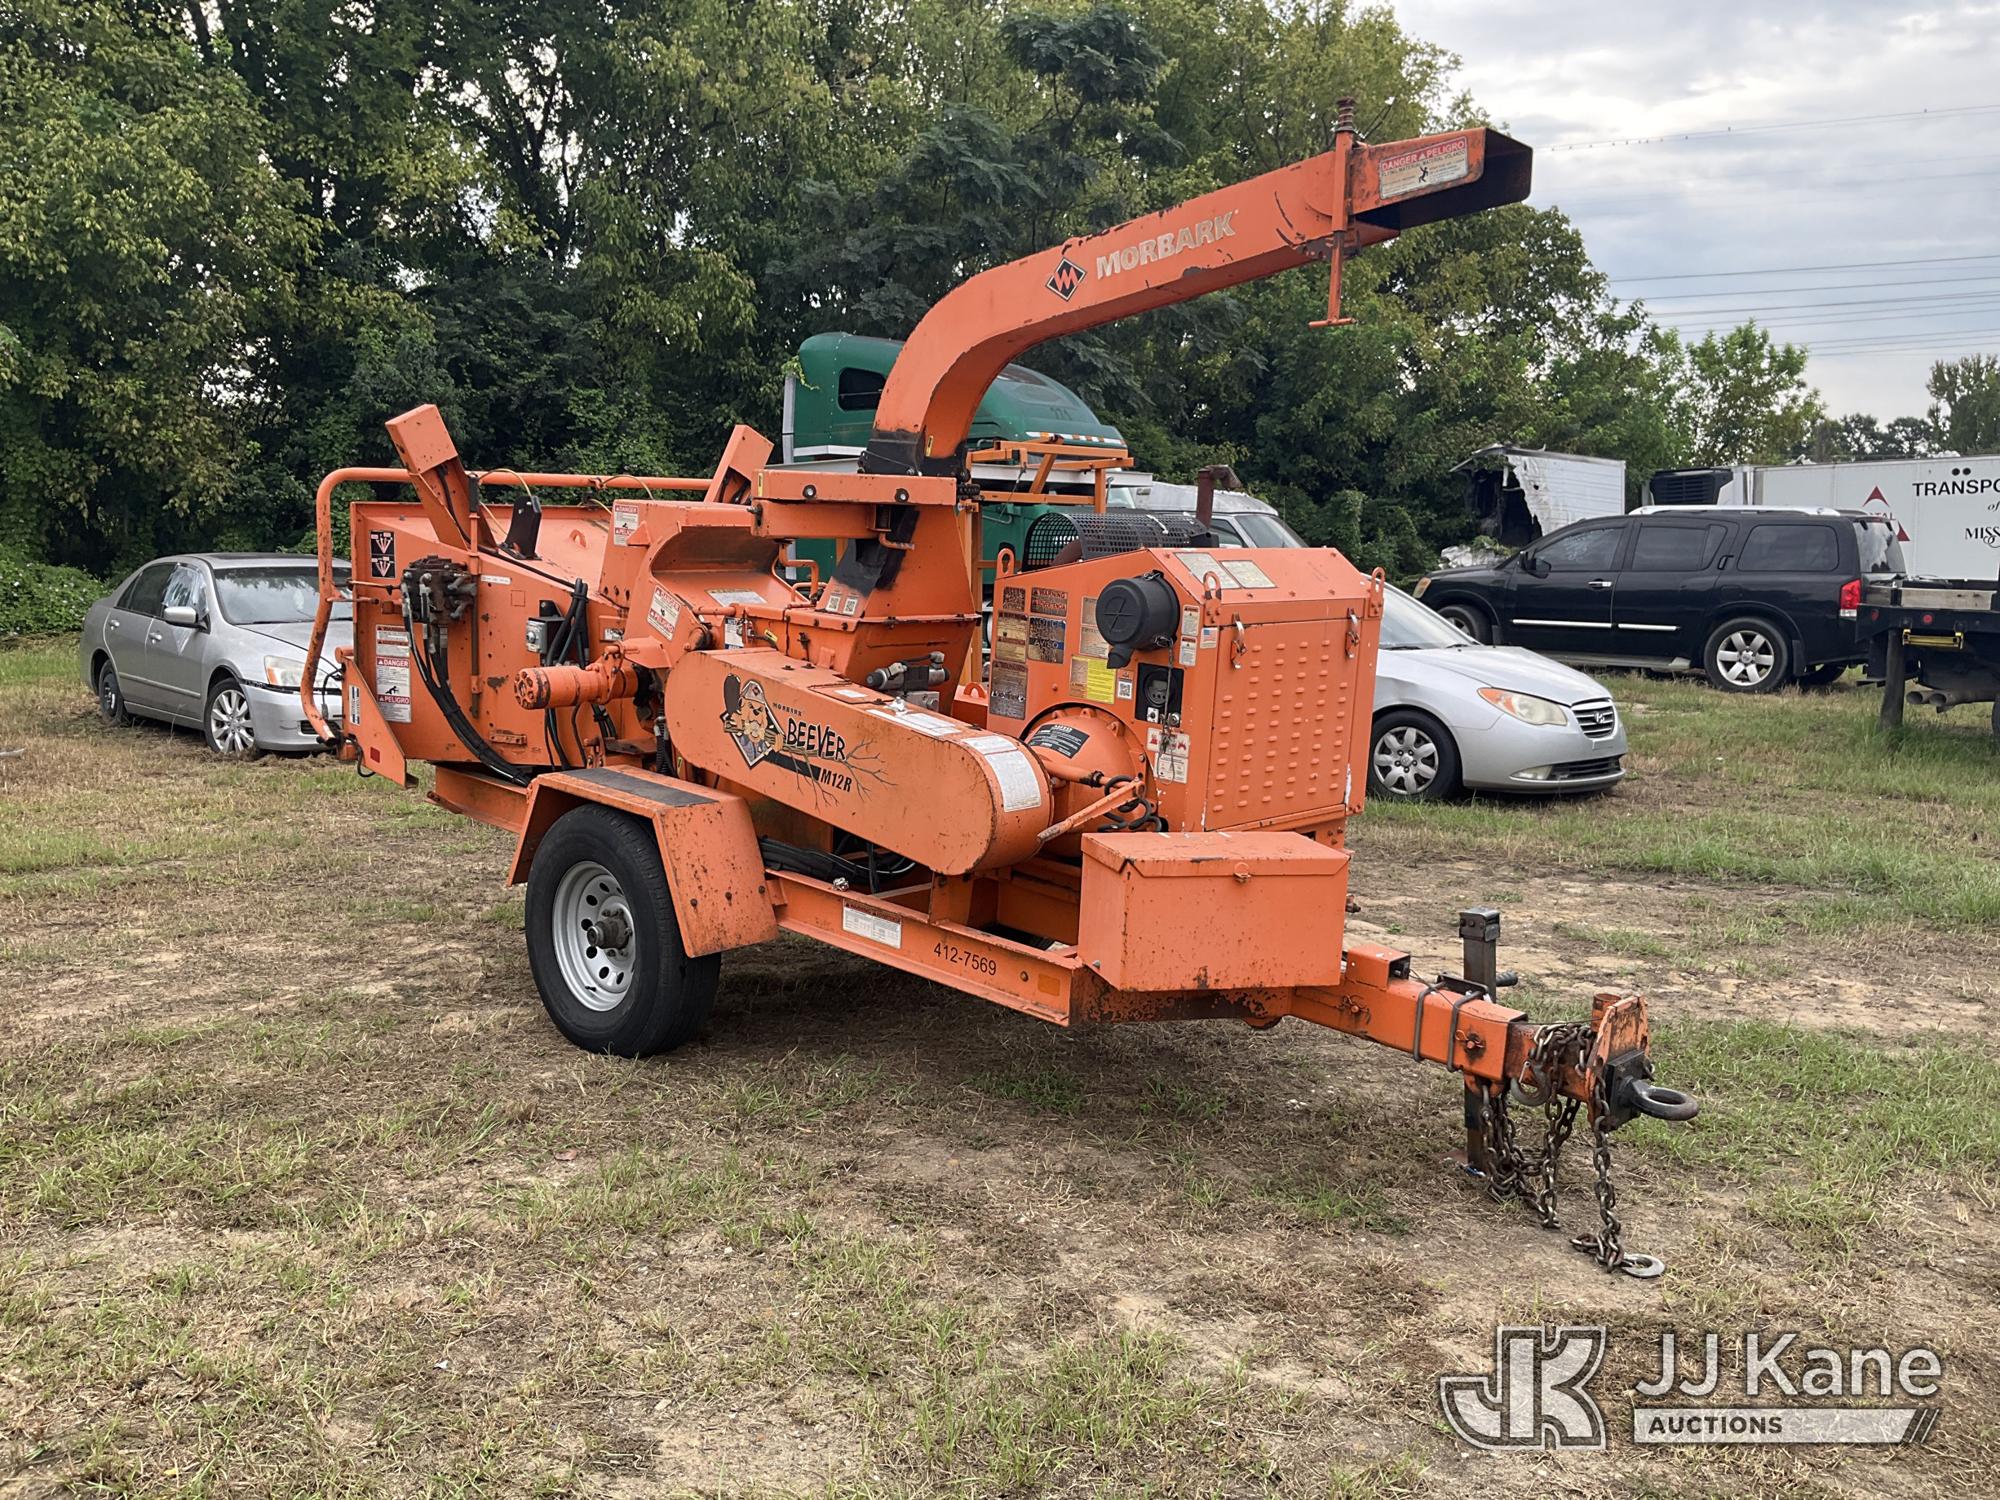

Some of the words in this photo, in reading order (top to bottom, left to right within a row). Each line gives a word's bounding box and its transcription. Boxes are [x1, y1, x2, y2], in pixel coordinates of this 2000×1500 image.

[1382, 153, 1418, 171] DANGER
[1426, 140, 1465, 158] PELIGRO
[1096, 211, 1236, 280] MORBARK
[1034, 639, 1059, 649] AVISO
[383, 659, 409, 667] DANGER
[384, 695, 410, 704] PELIGRO
[787, 718, 846, 760] BEEVER
[820, 768, 852, 793] M12R
[933, 942, 997, 976] 412-7569
